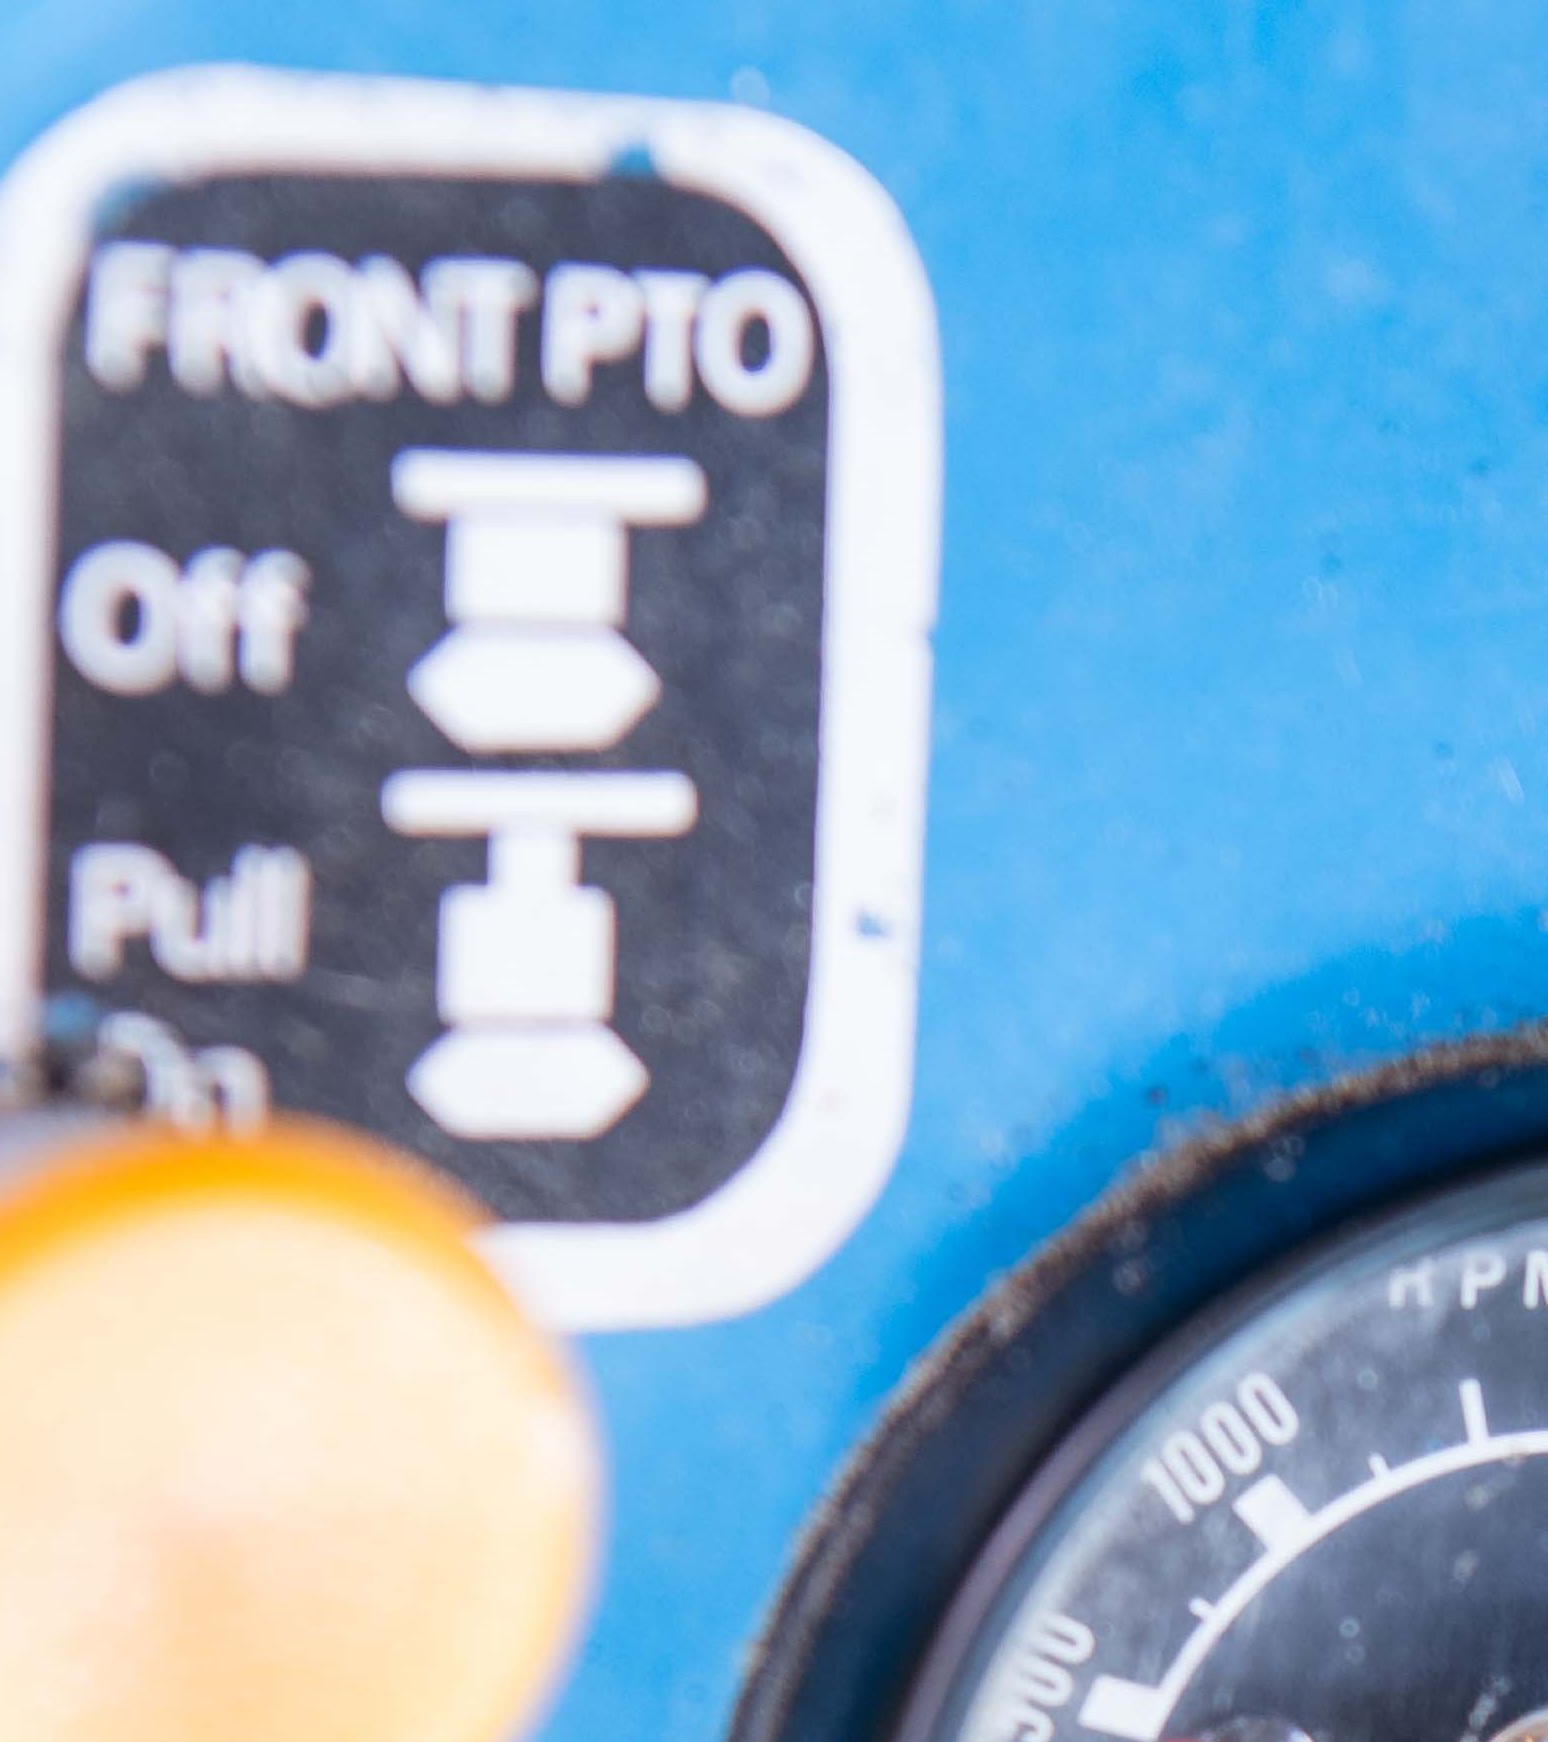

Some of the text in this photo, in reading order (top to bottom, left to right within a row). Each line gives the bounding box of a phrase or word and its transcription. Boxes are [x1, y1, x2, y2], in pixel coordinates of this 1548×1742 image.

[85, 241, 815, 416] FRONT PTO
[59, 541, 310, 694] Off
[68, 842, 311, 981] Pull
[1140, 1371, 1300, 1525] 1000
